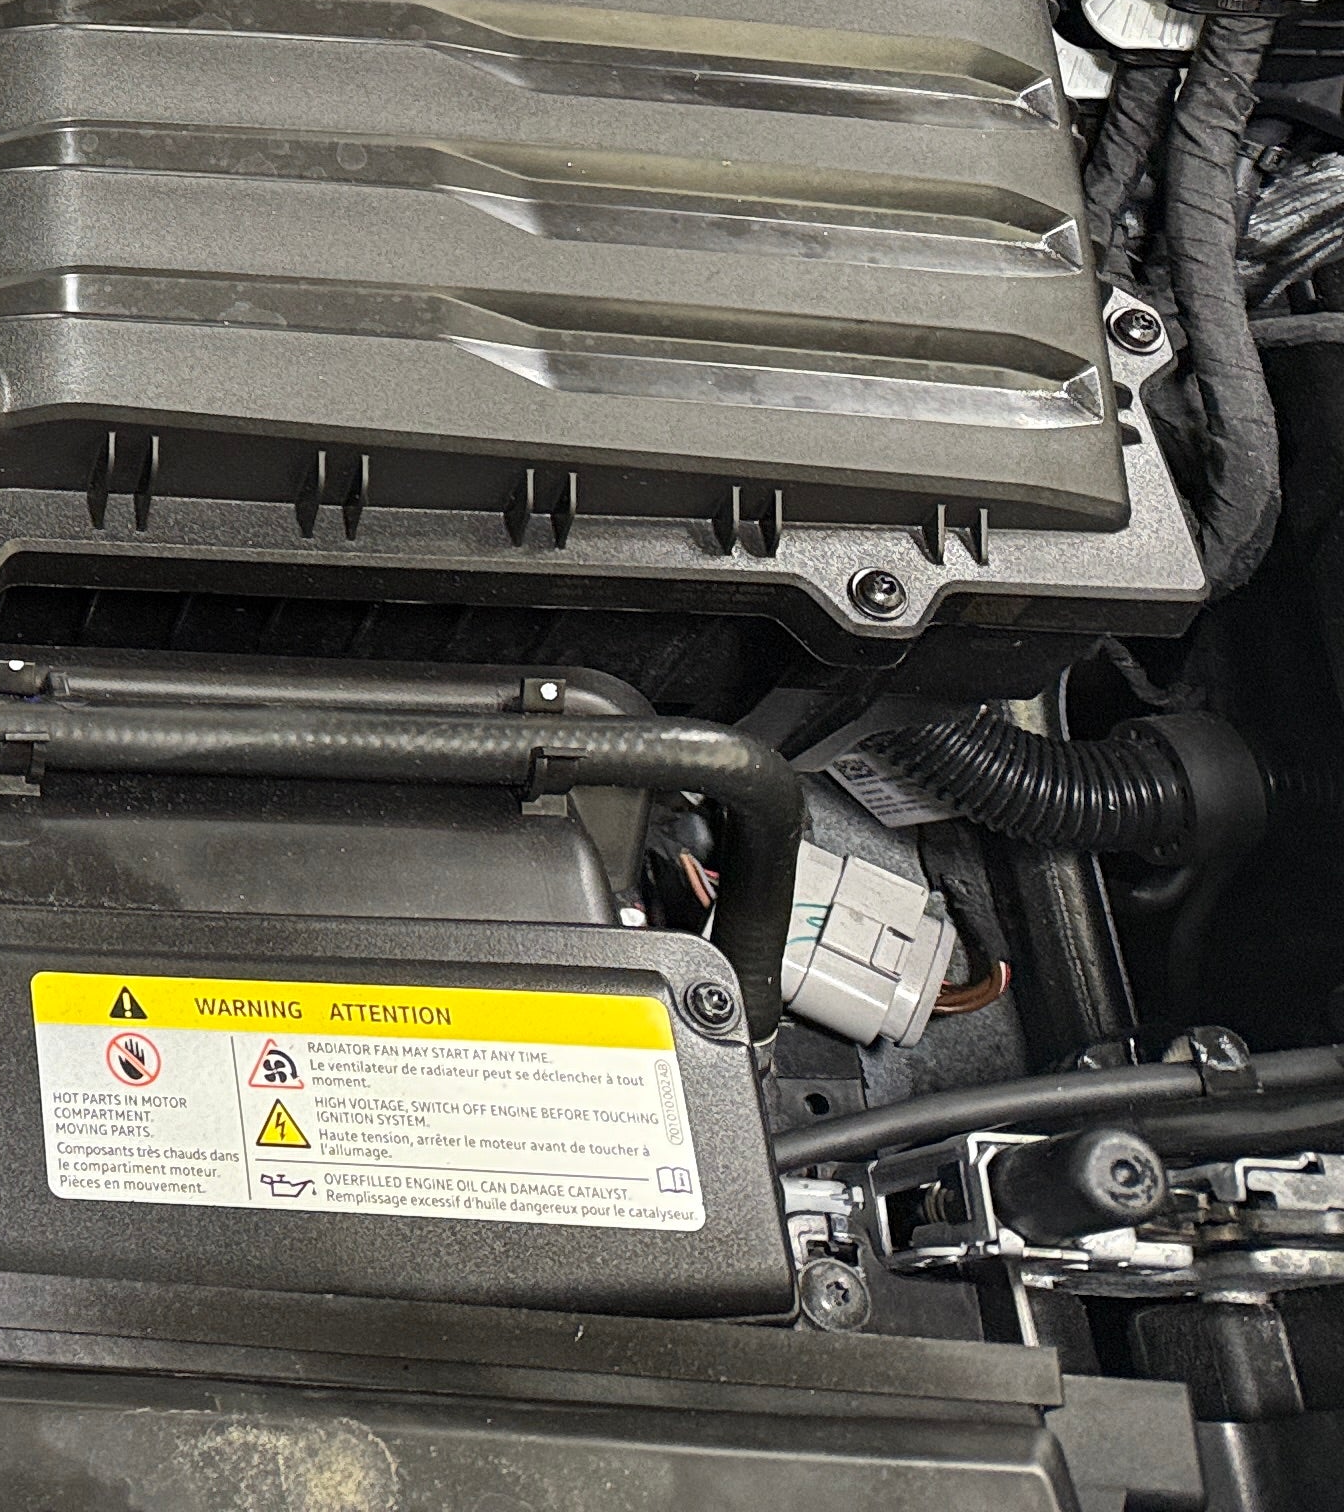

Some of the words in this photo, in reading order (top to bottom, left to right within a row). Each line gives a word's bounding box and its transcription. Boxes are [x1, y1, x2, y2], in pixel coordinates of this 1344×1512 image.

[194, 996, 303, 1021] WARNING
[329, 1001, 454, 1026] ATTENTION
[307, 1042, 371, 1056] RADIATOR
[374, 1044, 399, 1057] FAN
[402, 1046, 429, 1058] MAY
[433, 1047, 469, 1060] START
[473, 1049, 487, 1061] AT
[491, 1050, 515, 1062] ANY
[518, 1051, 553, 1064] TIME.
[310, 1059, 325, 1071] Le
[327, 1060, 398, 1074] ventilateur
[402, 1062, 417, 1075] de
[421, 1064, 479, 1078] radiateur
[483, 1069, 511, 1081] peut
[515, 1071, 529, 1080] se
[533, 1070, 602, 1085] déclencher
[606, 1074, 613, 1085] à
[617, 1075, 644, 1086] tout
[312, 1076, 371, 1088] moment.
[53, 1092, 79, 1104] HOT
[82, 1093, 121, 1106] PARTS
[125, 1095, 138, 1107] IN
[142, 1096, 187, 1109] MOTOR
[54, 1107, 154, 1122] COMPARTMENT.
[315, 1097, 346, 1109] HIGH
[349, 1098, 409, 1113] VOLTAGE,
[411, 1101, 459, 1115] SWITCH
[463, 1103, 487, 1115] OFF
[491, 1105, 538, 1119] ENGINE
[541, 1108, 590, 1122] BEFORE
[593, 1110, 659, 1125] TOUCHING
[317, 1111, 374, 1124] IGNITION
[377, 1114, 430, 1128] SYSTEM.
[55, 1123, 108, 1136] MOVING
[111, 1124, 154, 1138] PARTS.
[57, 1141, 134, 1158] Composants
[137, 1145, 160, 1158] très
[163, 1148, 207, 1161] chauds
[209, 1149, 239, 1162] dans
[319, 1128, 358, 1142] Haute
[361, 1131, 413, 1147] tension,
[417, 1134, 460, 1147] arrêter
[464, 1135, 476, 1148] le
[480, 1139, 526, 1151] moteur
[530, 1141, 567, 1153] avant
[570, 1141, 586, 1154] de
[590, 1143, 638, 1157] toucher
[643, 1145, 650, 1157] à
[321, 1143, 392, 1160] l'allumage.
[58, 1158, 70, 1170] le
[74, 1161, 166, 1175] compartiment
[170, 1164, 221, 1178] moteur.
[60, 1175, 100, 1188] Pièces
[104, 1177, 120, 1189] en
[324, 1172, 402, 1188] OVERFILLED
[406, 1177, 454, 1190] ENGINE
[457, 1180, 478, 1192] OIL
[481, 1181, 506, 1194] CAN
[511, 1182, 565, 1197] DAMAGE
[569, 1185, 632, 1201] CATALYST.
[326, 1189, 407, 1208] Remplissage
[411, 1194, 460, 1208] excessif
[464, 1196, 507, 1211] d'huile
[510, 1199, 578, 1215] dangereux
[582, 1205, 610, 1217] pour
[614, 1205, 625, 1217] le
[629, 1207, 698, 1222] catalyseur.
